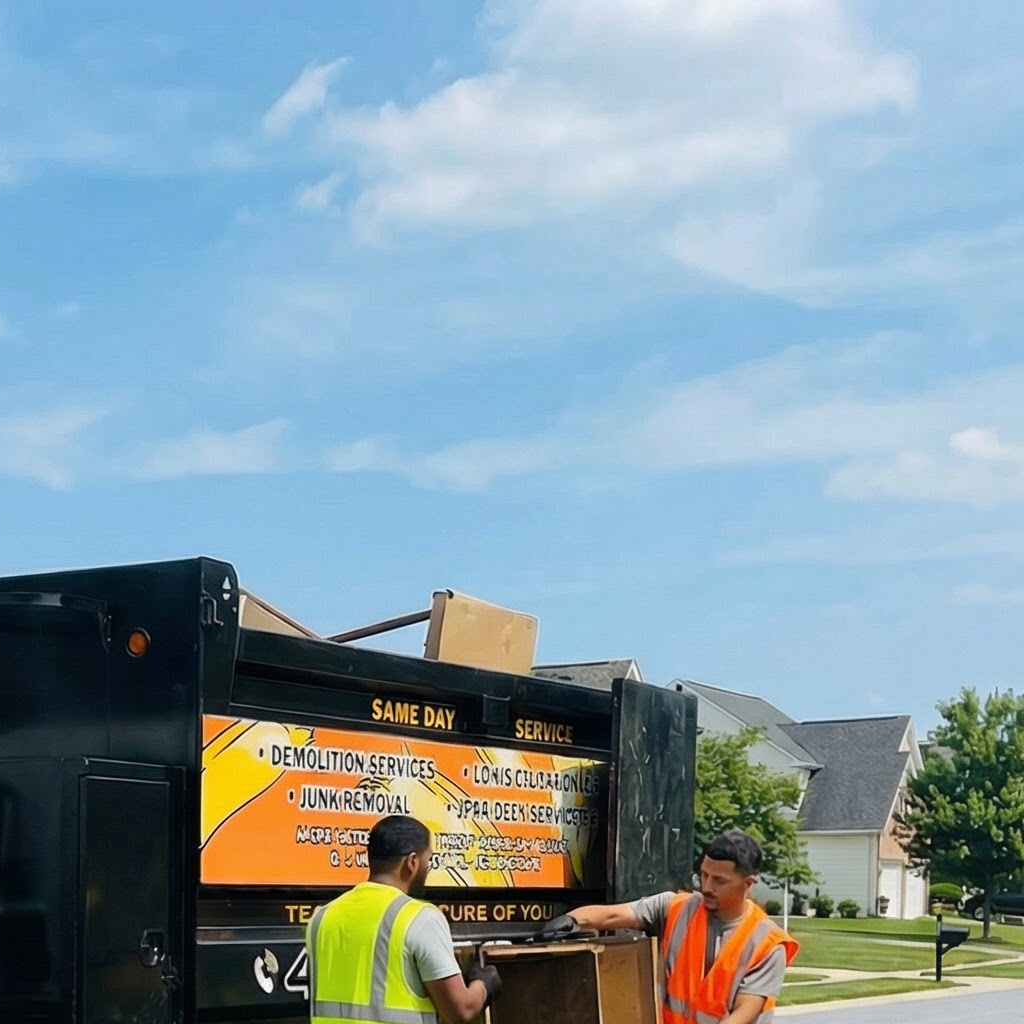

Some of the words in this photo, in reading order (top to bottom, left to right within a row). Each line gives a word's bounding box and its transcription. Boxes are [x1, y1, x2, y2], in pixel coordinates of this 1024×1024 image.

[372, 698, 419, 725] SAME
[424, 705, 456, 730] DAY
[515, 718, 574, 744] SERVICE
[271, 744, 365, 773] DEMOLITION
[369, 754, 436, 780] SERVICES
[300, 787, 339, 811] JUNK
[343, 790, 410, 814] REMOVAL
[493, 904, 516, 921] OF
